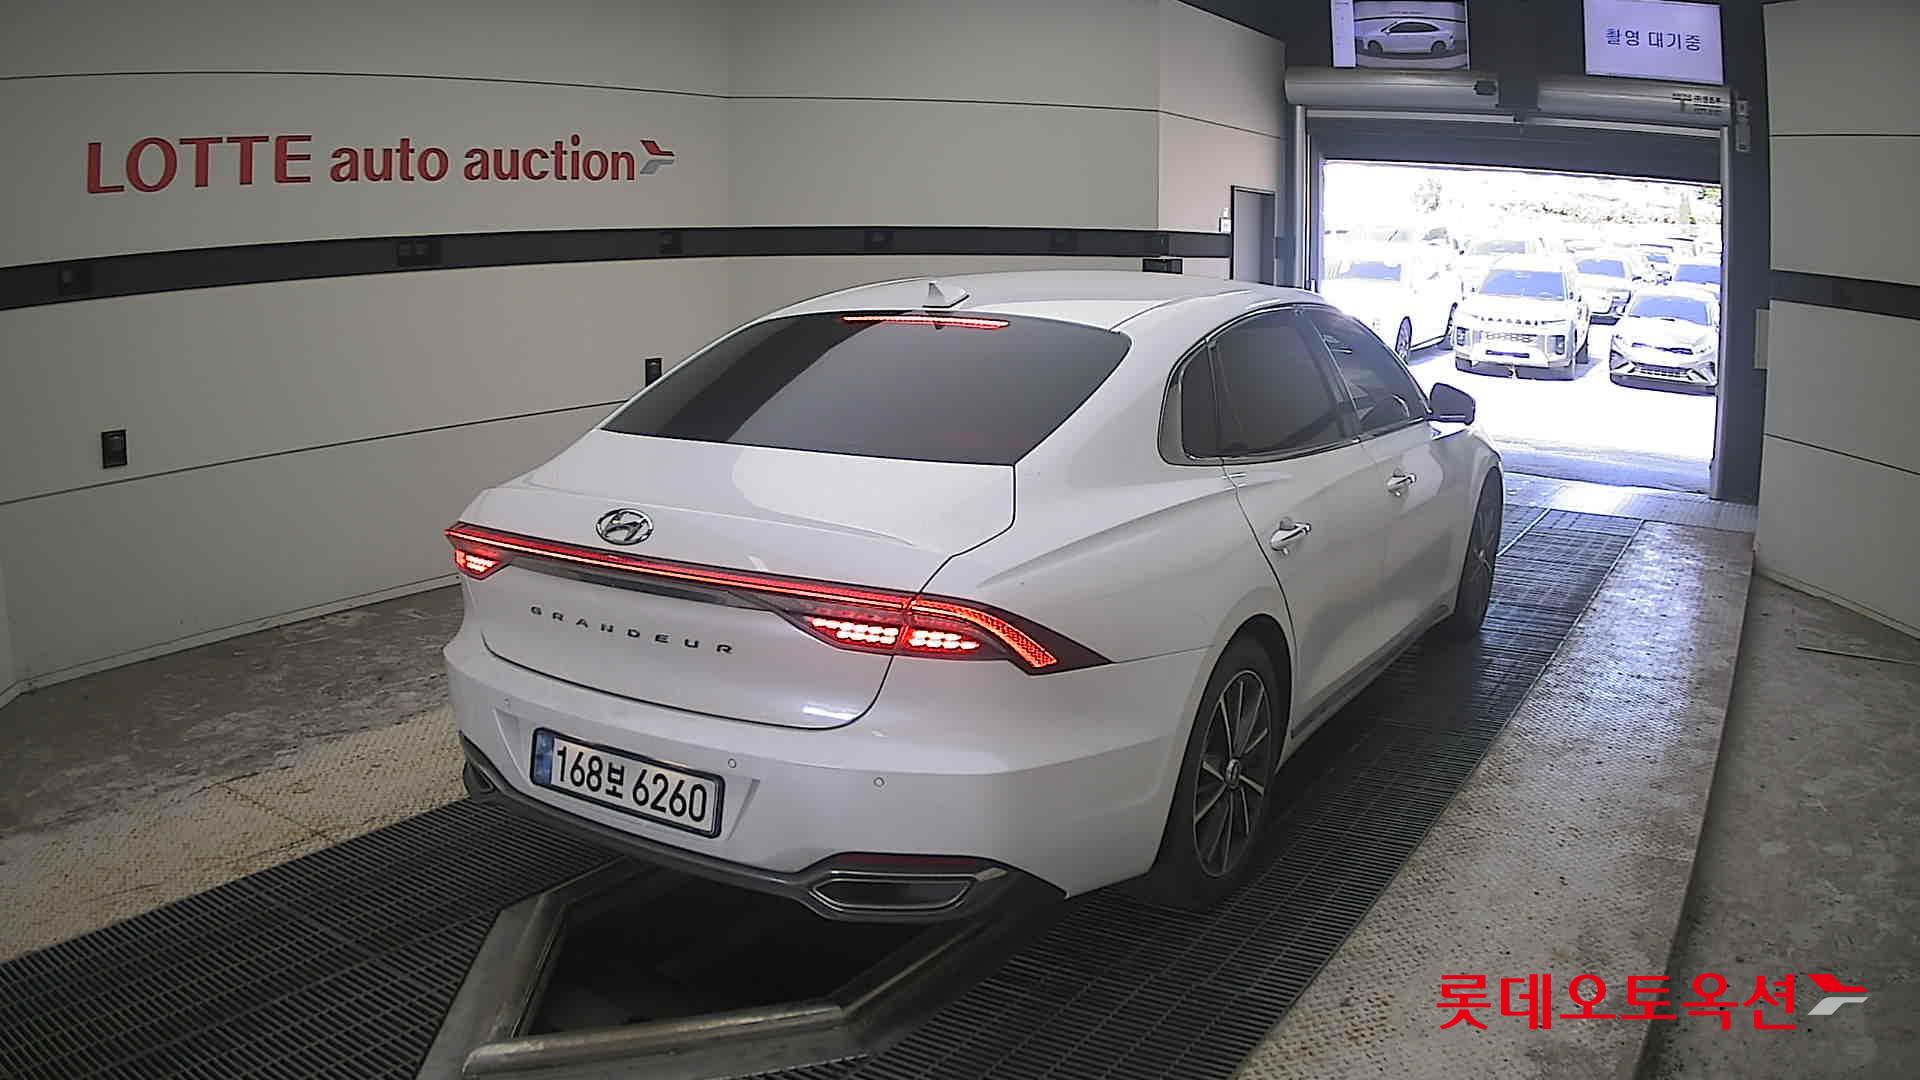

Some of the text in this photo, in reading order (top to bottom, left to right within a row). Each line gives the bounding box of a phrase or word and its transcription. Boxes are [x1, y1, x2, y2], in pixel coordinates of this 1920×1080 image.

[1649, 32, 1702, 52] 대기중
[87, 134, 635, 194] LOTTE auto auction
[530, 606, 733, 654] GRANDEUR
[557, 746, 708, 823] 168보 6260
